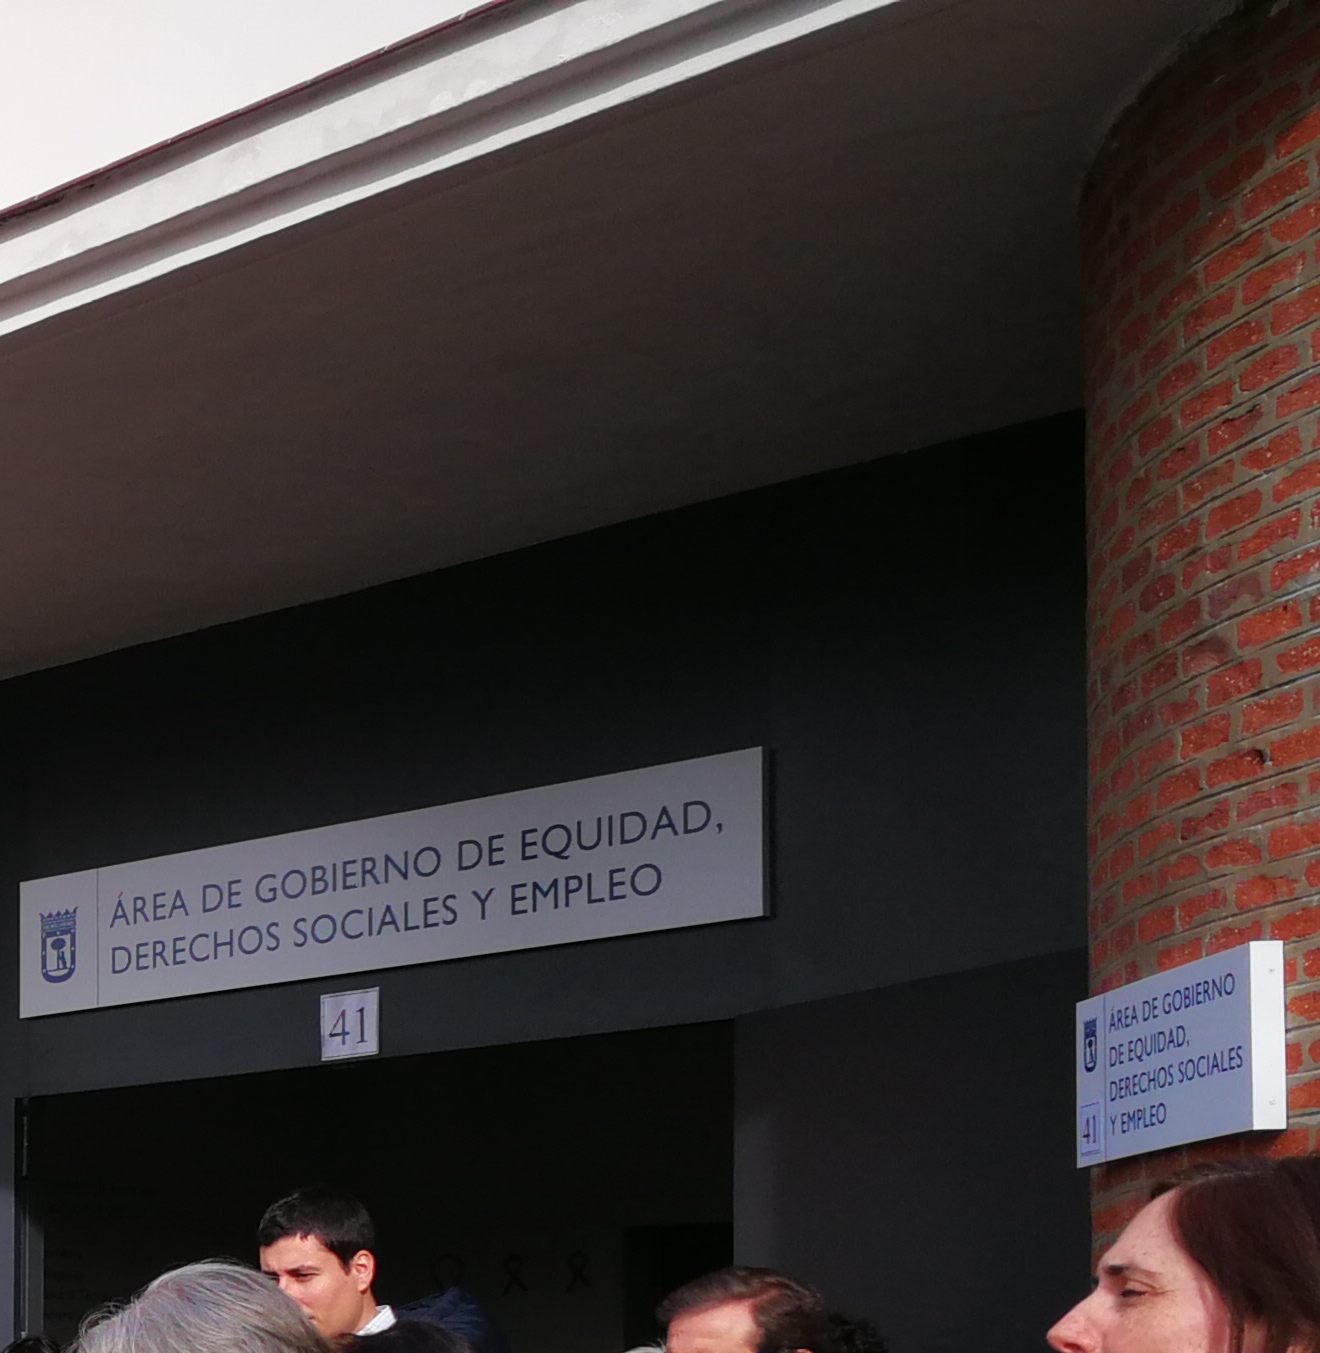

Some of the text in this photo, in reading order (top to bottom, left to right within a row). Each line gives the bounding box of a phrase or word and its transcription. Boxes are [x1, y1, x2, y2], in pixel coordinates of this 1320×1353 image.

[110, 800, 723, 928] ÁREA DE GOBIERNO DE EQUIDAD,
[111, 863, 662, 974] DERECHOS SOCIALES Y EMPLEO
[329, 1006, 368, 1045] 41
[1108, 972, 1236, 1034] ÁREA DE GOBIERNO
[1109, 1024, 1191, 1068] DE EQUIDAD,
[1110, 1045, 1243, 1102] DERECHOS SOCIALES
[1082, 1114, 1097, 1145] 41
[1110, 1102, 1167, 1136] Y EMPLEO
